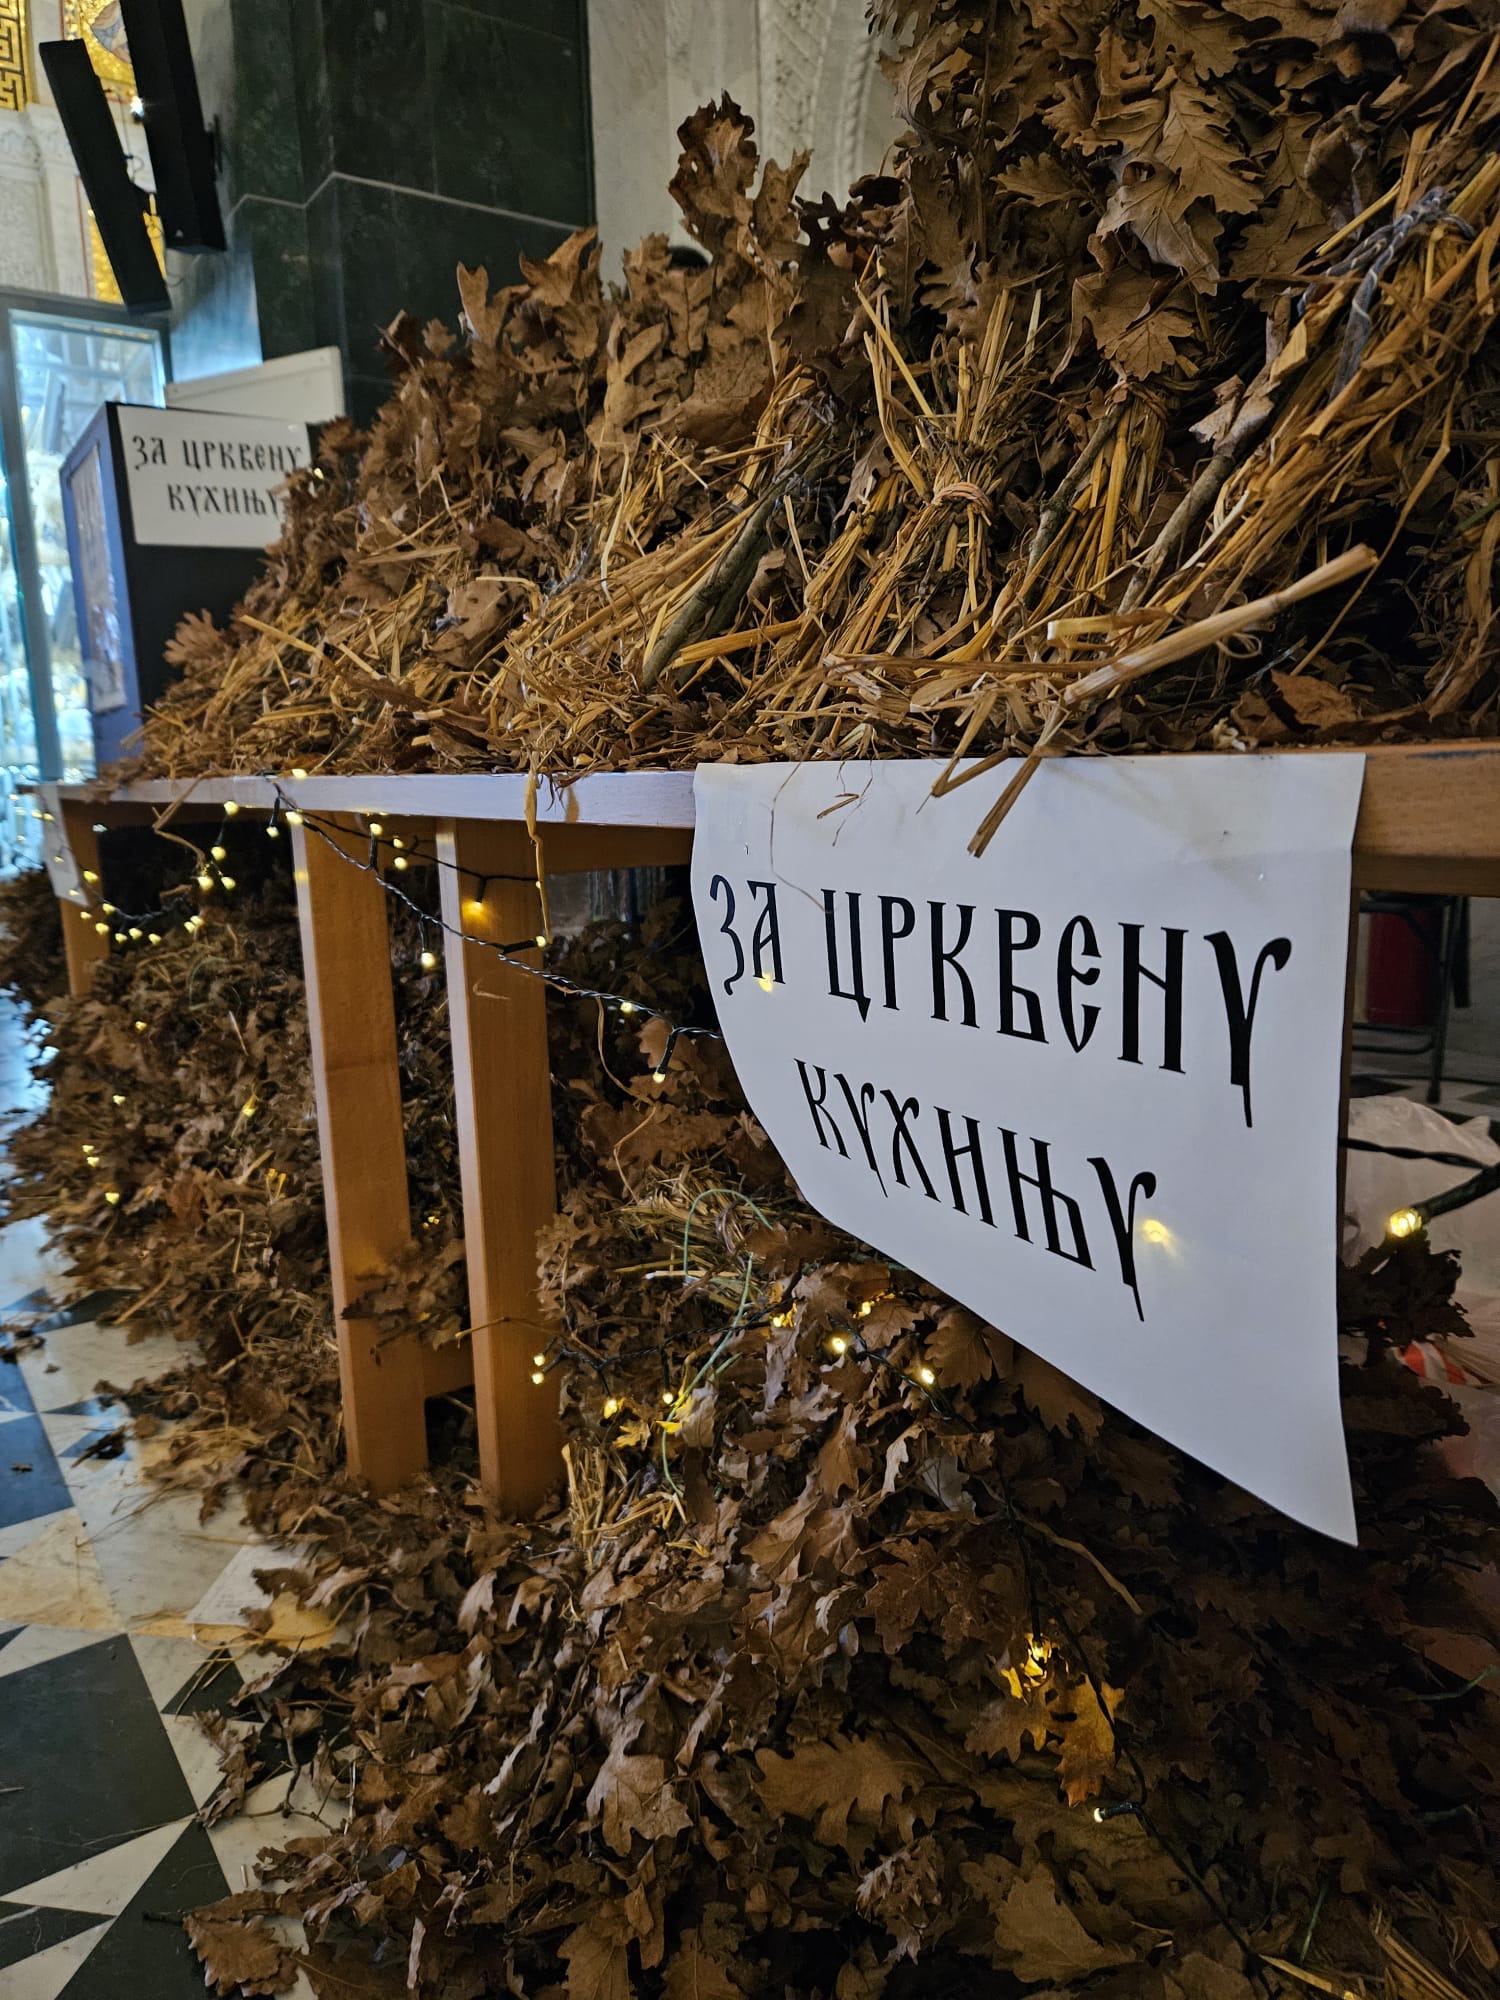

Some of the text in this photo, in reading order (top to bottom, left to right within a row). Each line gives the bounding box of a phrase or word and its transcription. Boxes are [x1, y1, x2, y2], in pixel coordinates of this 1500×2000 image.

[132, 435, 167, 471] ЗА
[709, 873, 1292, 1129] ЗА ЦРКВЕНУ
[793, 1057, 1157, 1322] КУХИЊУ
